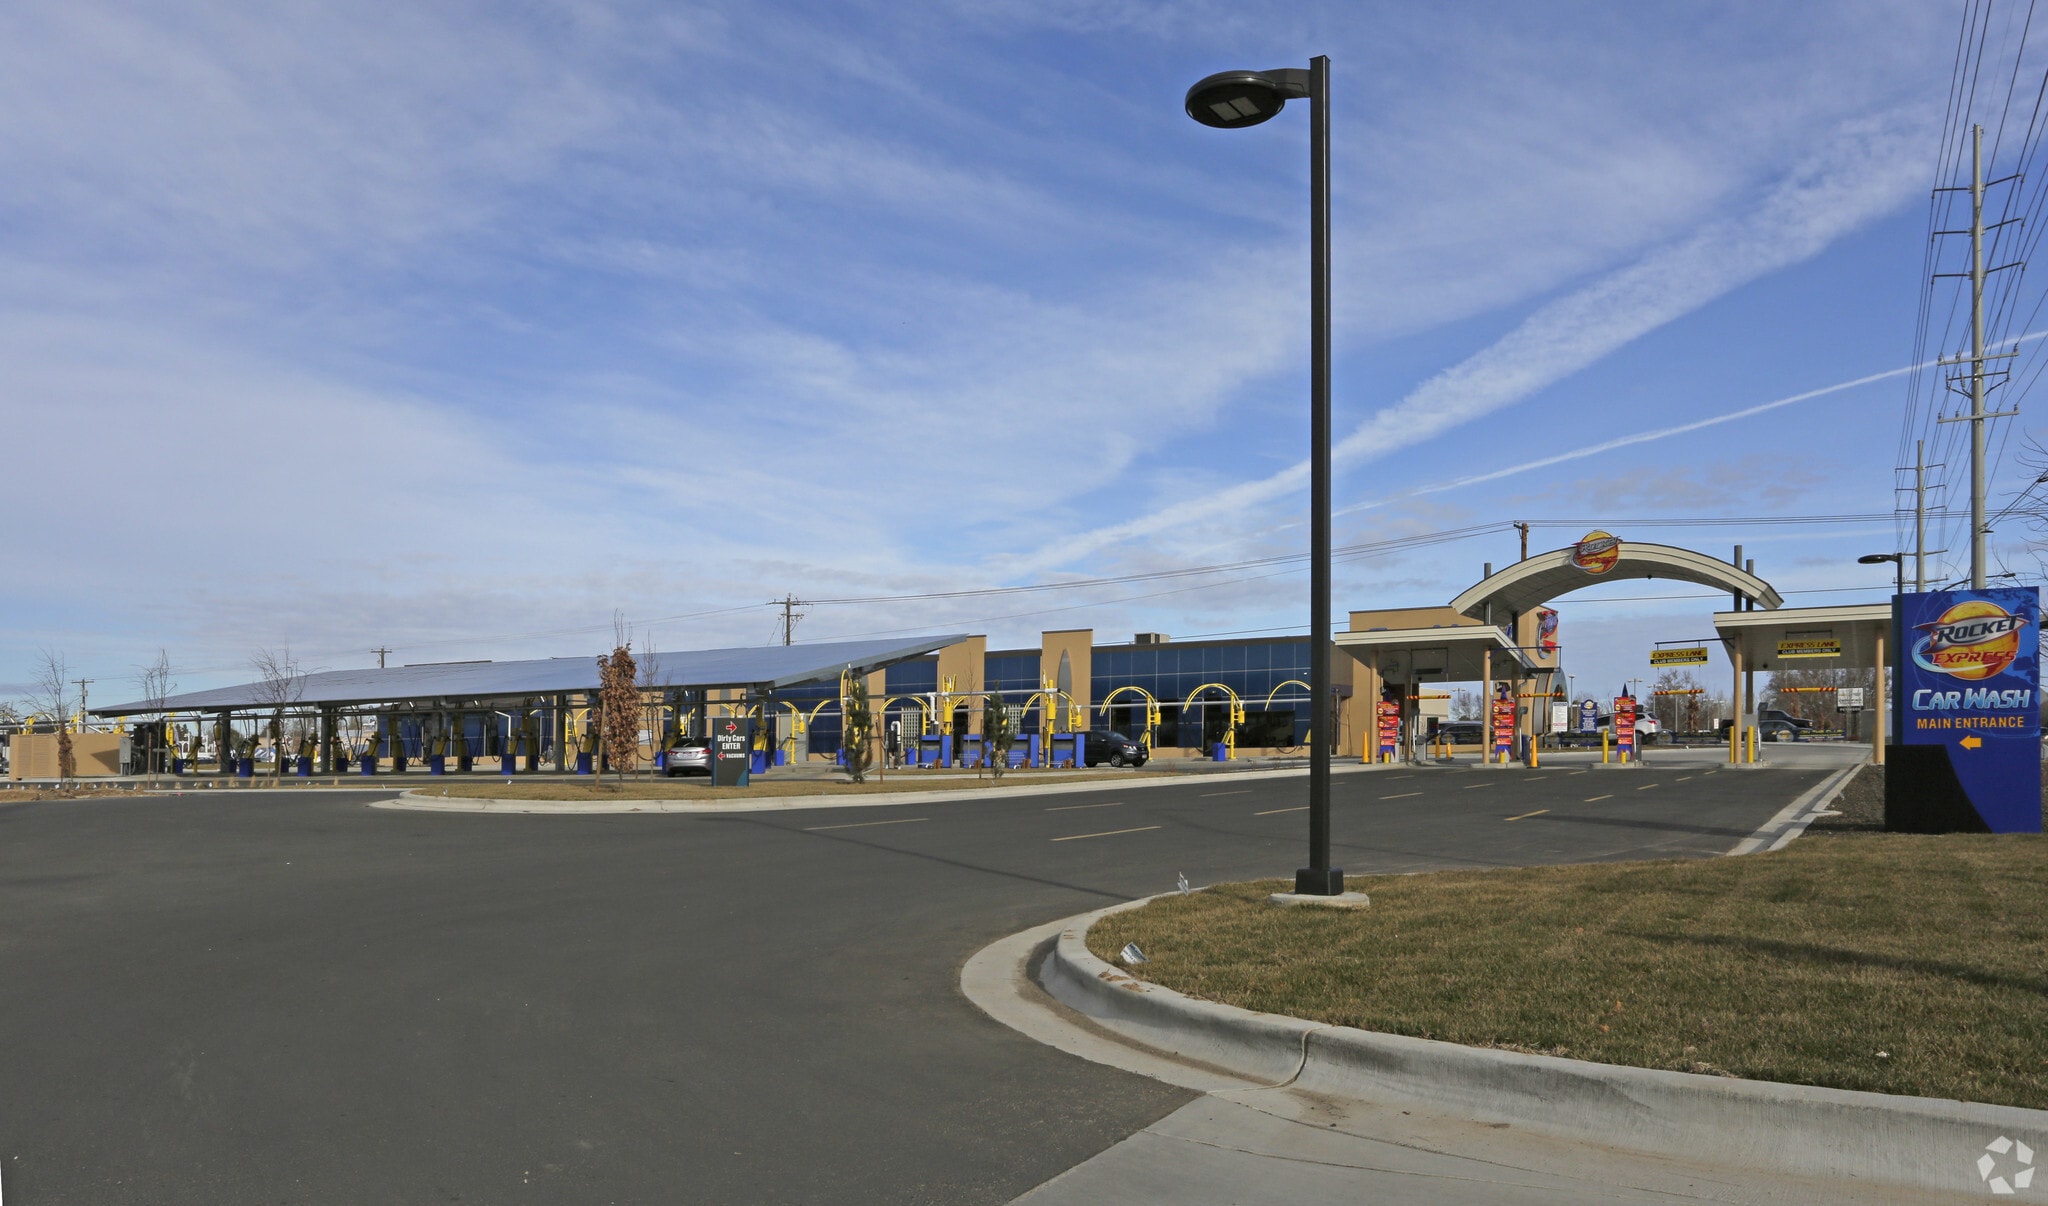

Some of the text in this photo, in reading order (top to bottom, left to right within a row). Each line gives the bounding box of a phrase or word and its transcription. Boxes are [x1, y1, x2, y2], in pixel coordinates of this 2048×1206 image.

[1937, 613, 2024, 643] ROCKET
[1652, 649, 1704, 659] EXPRESS LANE
[1934, 650, 2018, 664] EXPRESS
[1912, 687, 2031, 710] CAR WASH
[1917, 716, 2024, 729] MAIN ENTRANCE
[717, 734, 746, 743] Dirty Cars
[722, 742, 741, 750] ENTER
